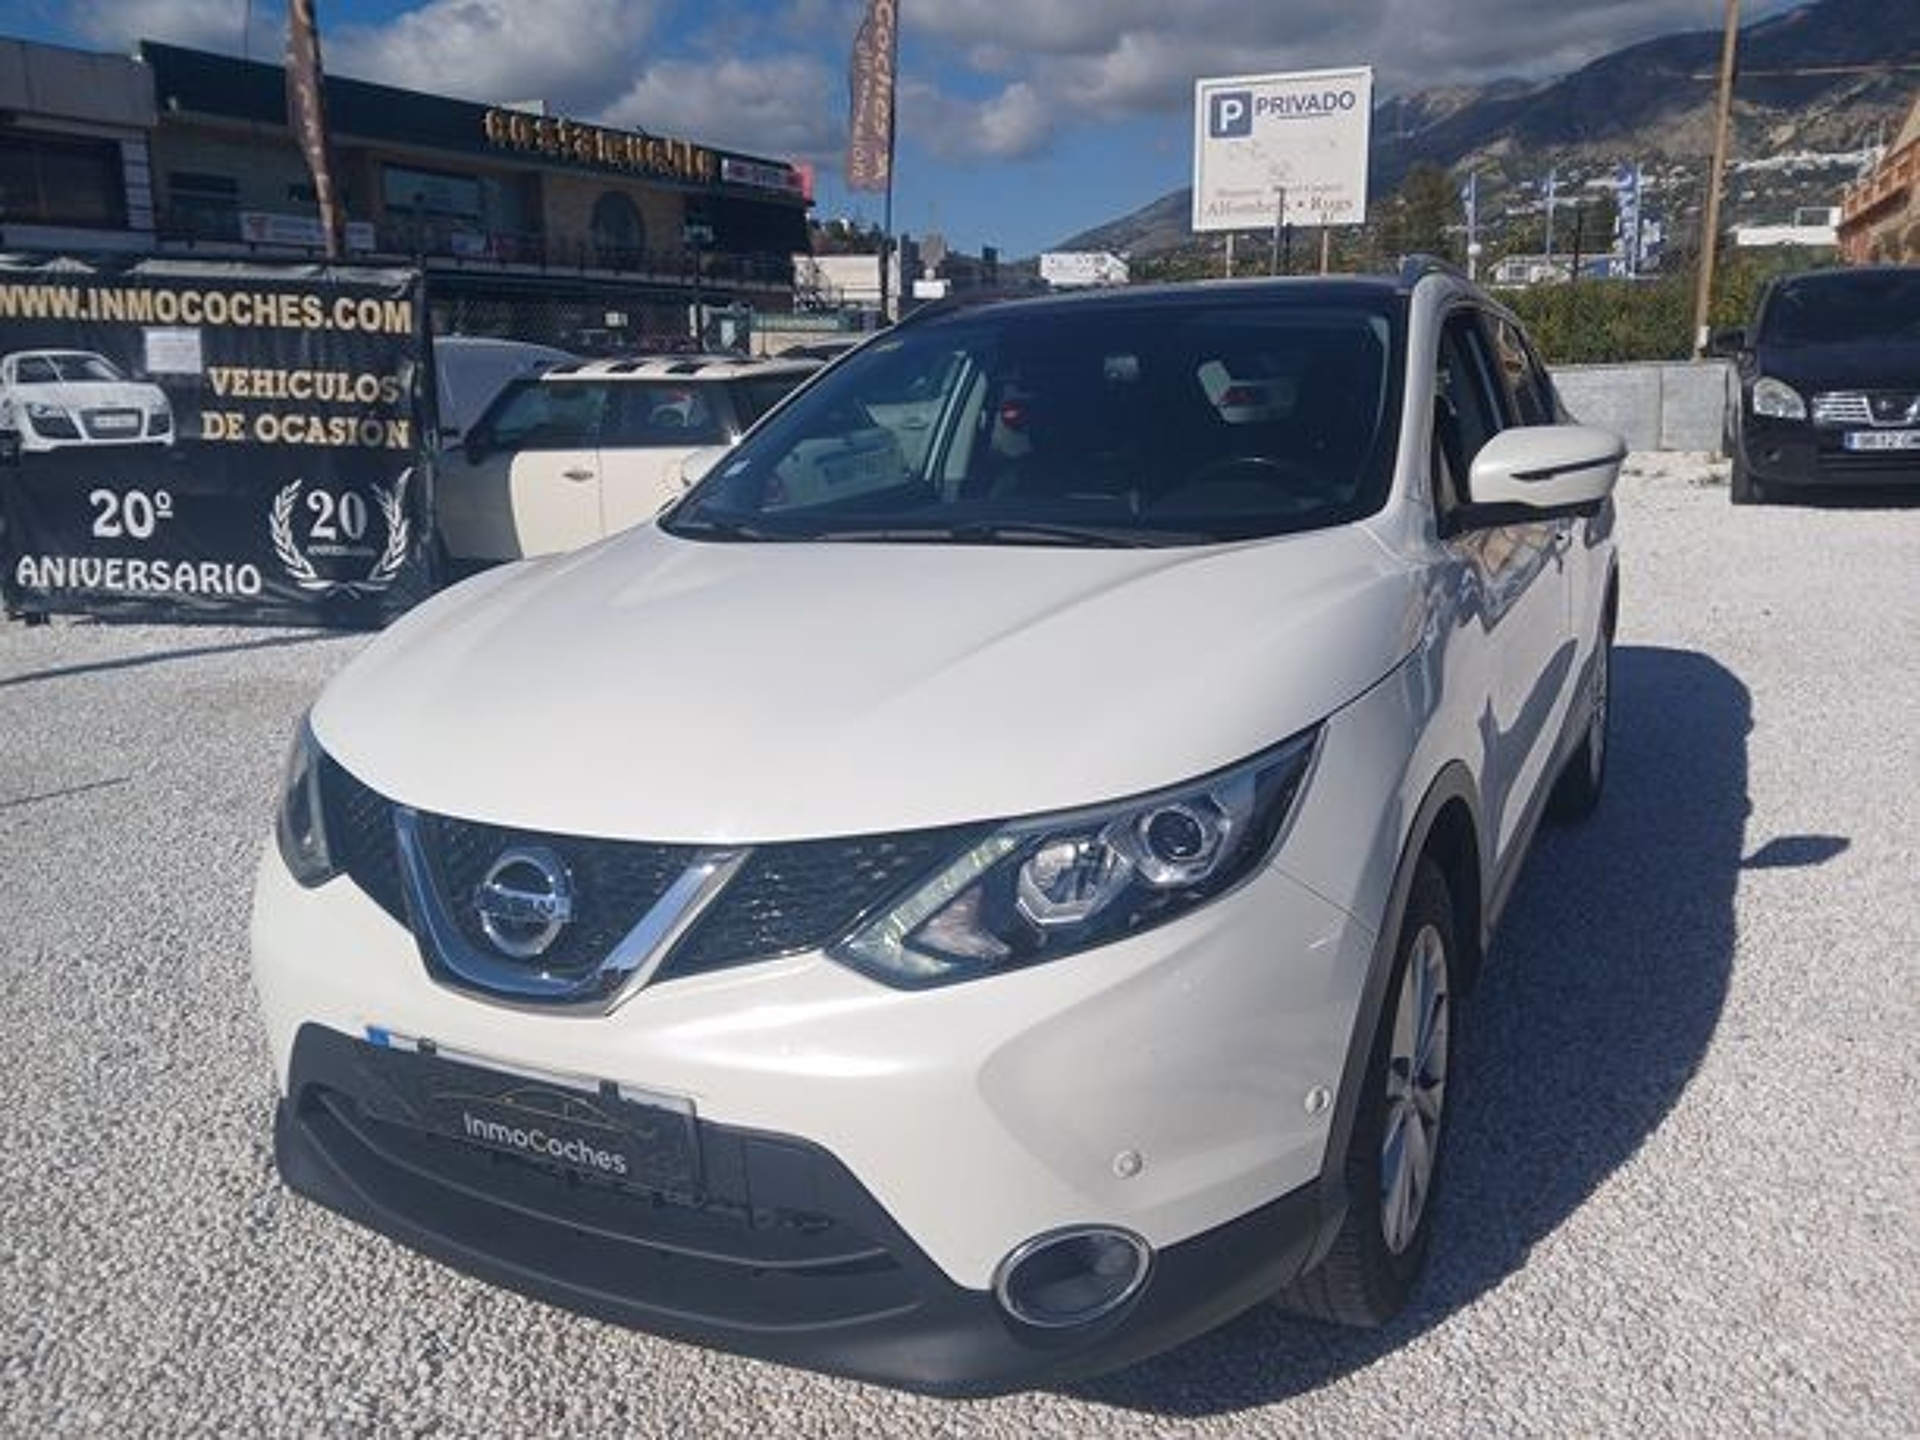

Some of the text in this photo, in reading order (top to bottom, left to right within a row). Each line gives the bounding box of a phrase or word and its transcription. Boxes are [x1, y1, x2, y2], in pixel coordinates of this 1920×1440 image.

[1219, 90, 1356, 133] P PRIVADO
[208, 366, 400, 403] VEHICULOS
[202, 411, 246, 442] DE
[306, 490, 369, 541] 20
[16, 554, 263, 595] ANIVERSARIO
[463, 1111, 627, 1175] InmoCoches
